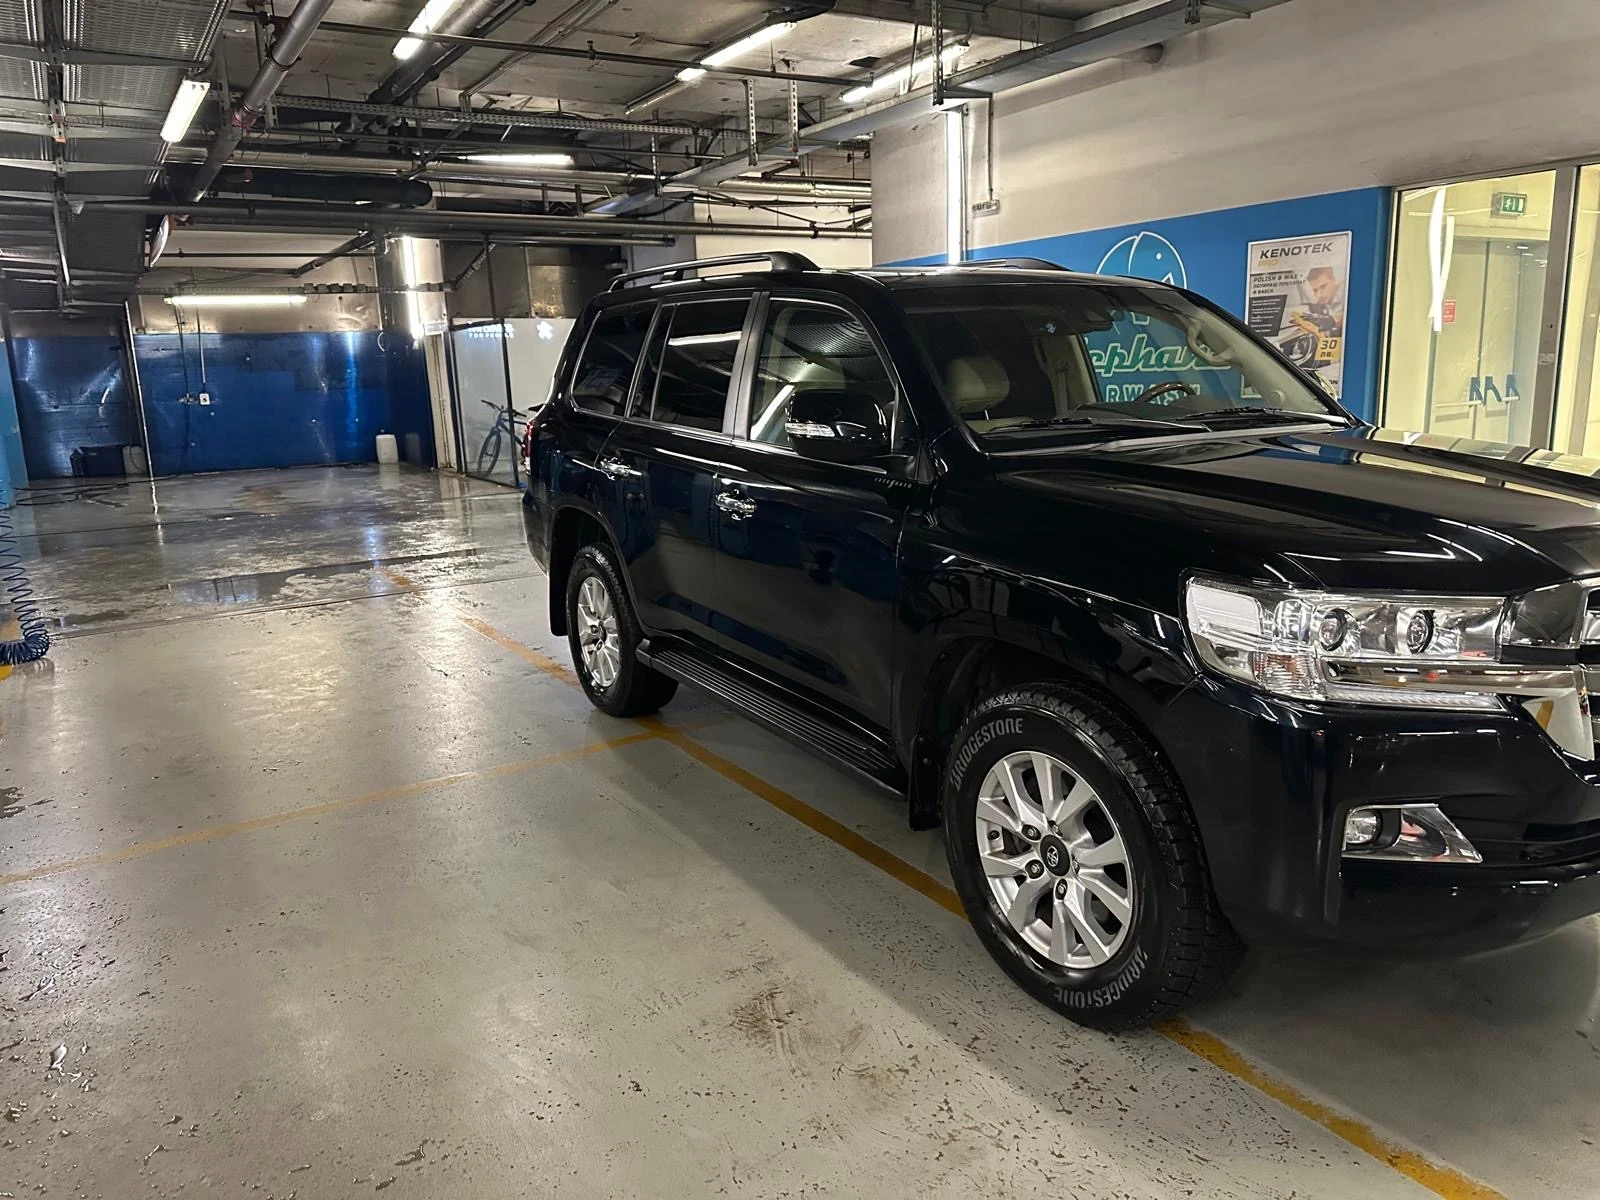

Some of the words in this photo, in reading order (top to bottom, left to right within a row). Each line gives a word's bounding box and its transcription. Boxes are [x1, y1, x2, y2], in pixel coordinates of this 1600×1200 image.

[1260, 243, 1332, 259] KENOTEK
[1253, 274, 1276, 283] POLISH
[1320, 339, 1338, 350] 30
[950, 718, 1024, 792] BRIDGESTONE
[1053, 944, 1149, 1009] BRIDGESTONE
